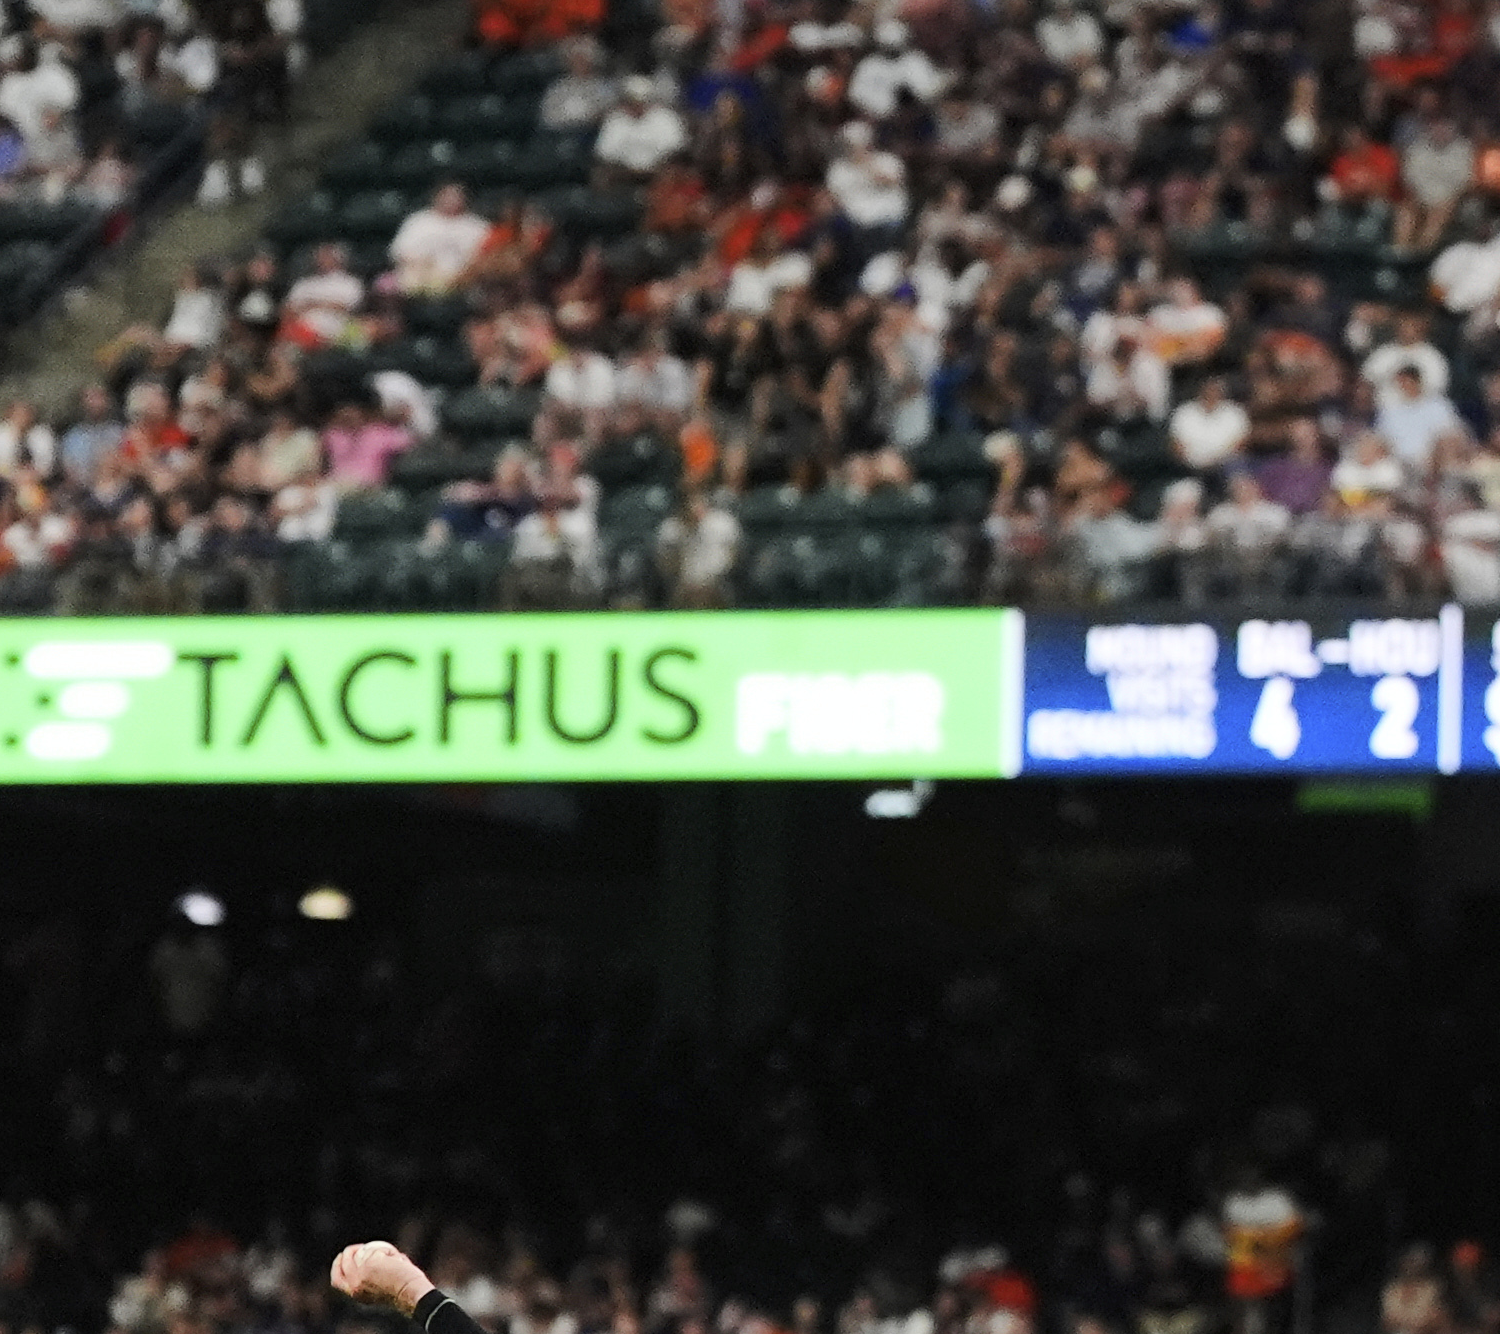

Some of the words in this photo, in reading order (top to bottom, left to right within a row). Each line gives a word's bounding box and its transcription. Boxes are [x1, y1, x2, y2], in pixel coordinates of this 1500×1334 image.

[178, 645, 701, 750] TACHUS
[1249, 676, 1302, 760] 4
[1368, 675, 1420, 759] 2
